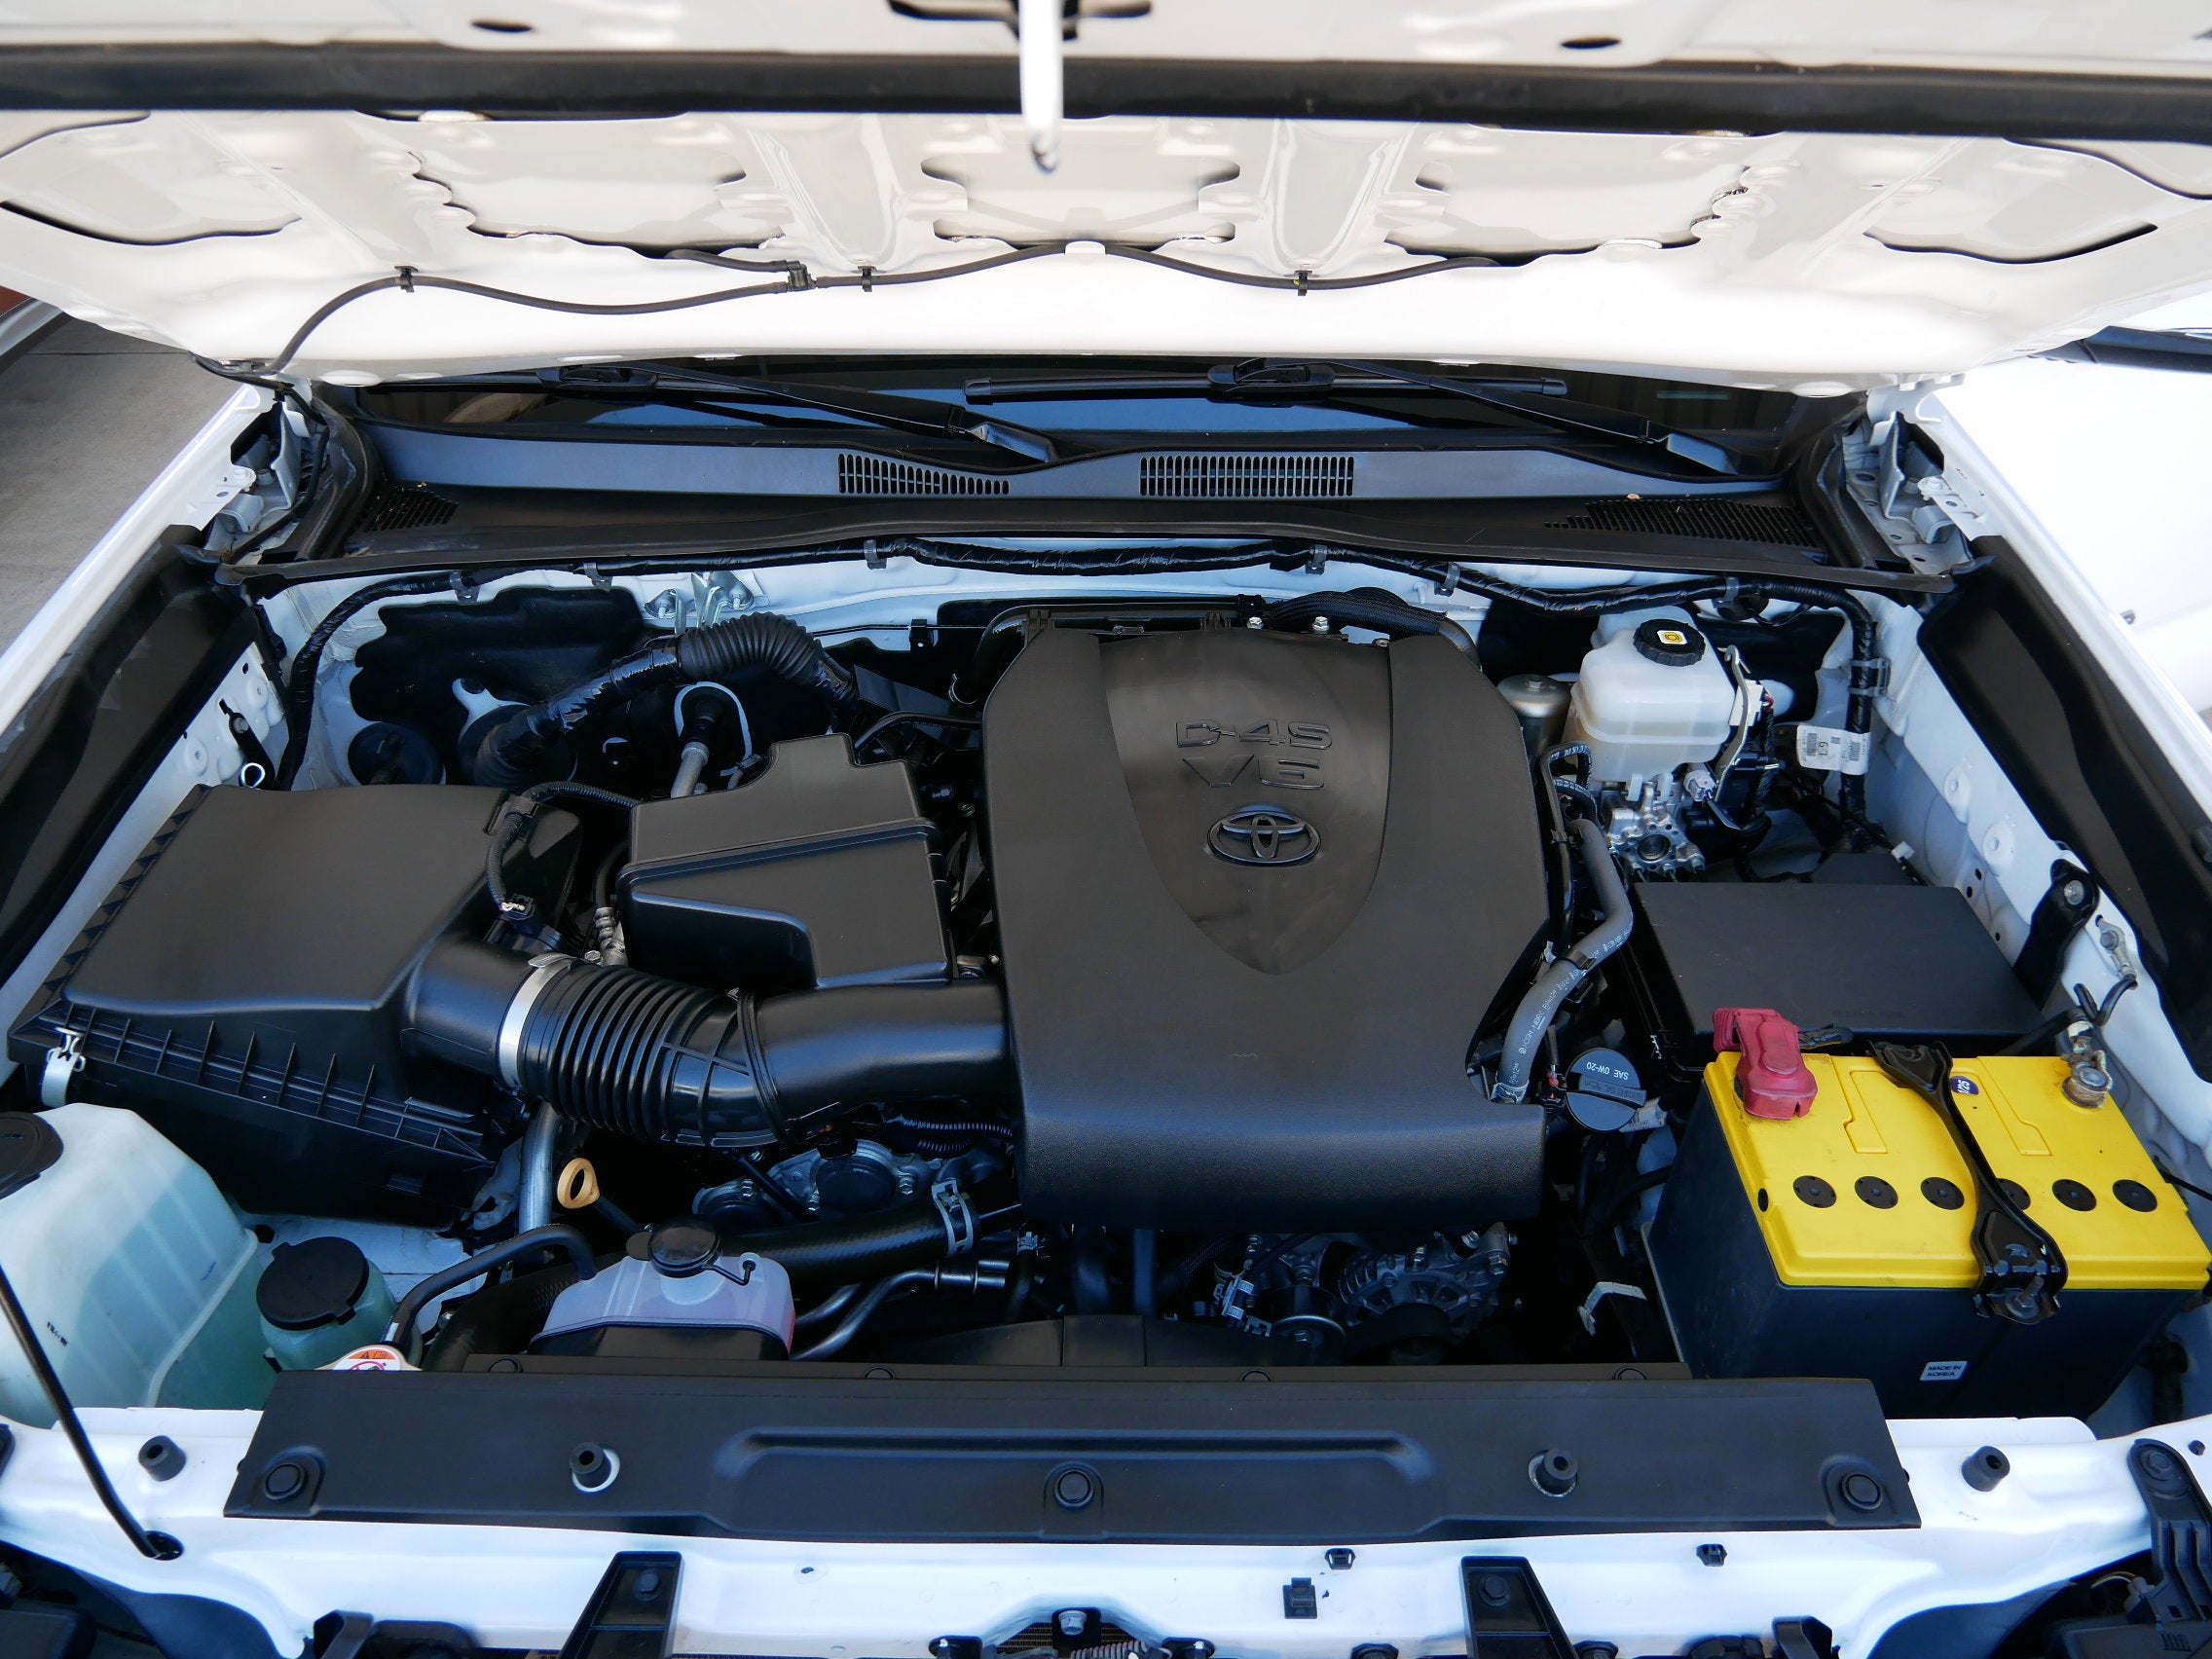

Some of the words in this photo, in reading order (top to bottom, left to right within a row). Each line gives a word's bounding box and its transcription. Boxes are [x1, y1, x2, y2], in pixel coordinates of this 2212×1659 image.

[1176, 719, 1333, 750] D-4S
[1182, 755, 1325, 790] V6
[1586, 1061, 1610, 1075] 0W-20
[1613, 1069, 1629, 1081] SAE
